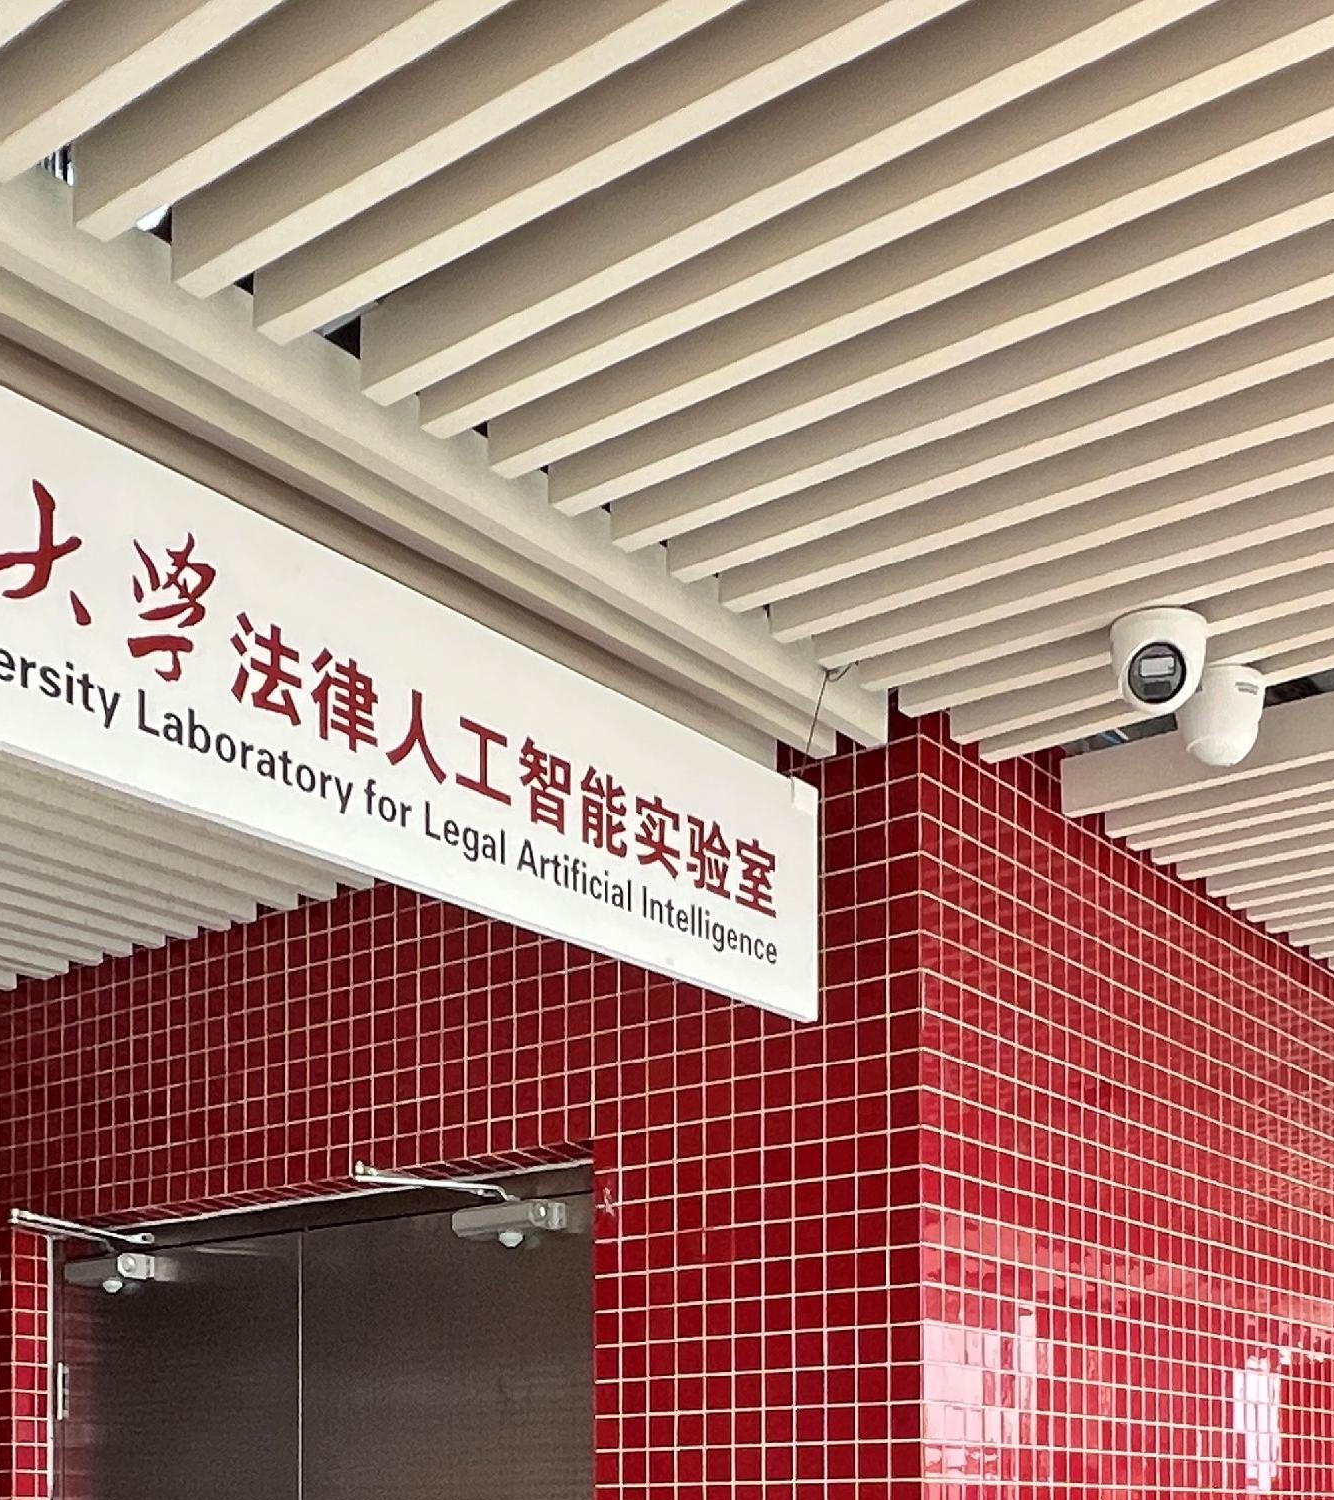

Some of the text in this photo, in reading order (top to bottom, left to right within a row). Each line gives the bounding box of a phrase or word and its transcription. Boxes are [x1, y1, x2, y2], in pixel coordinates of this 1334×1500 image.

[136, 688, 354, 815] Laboratory
[362, 778, 413, 828] for
[424, 800, 507, 866] Legal
[516, 839, 633, 914] Artificial
[641, 884, 778, 966] Intelligence
